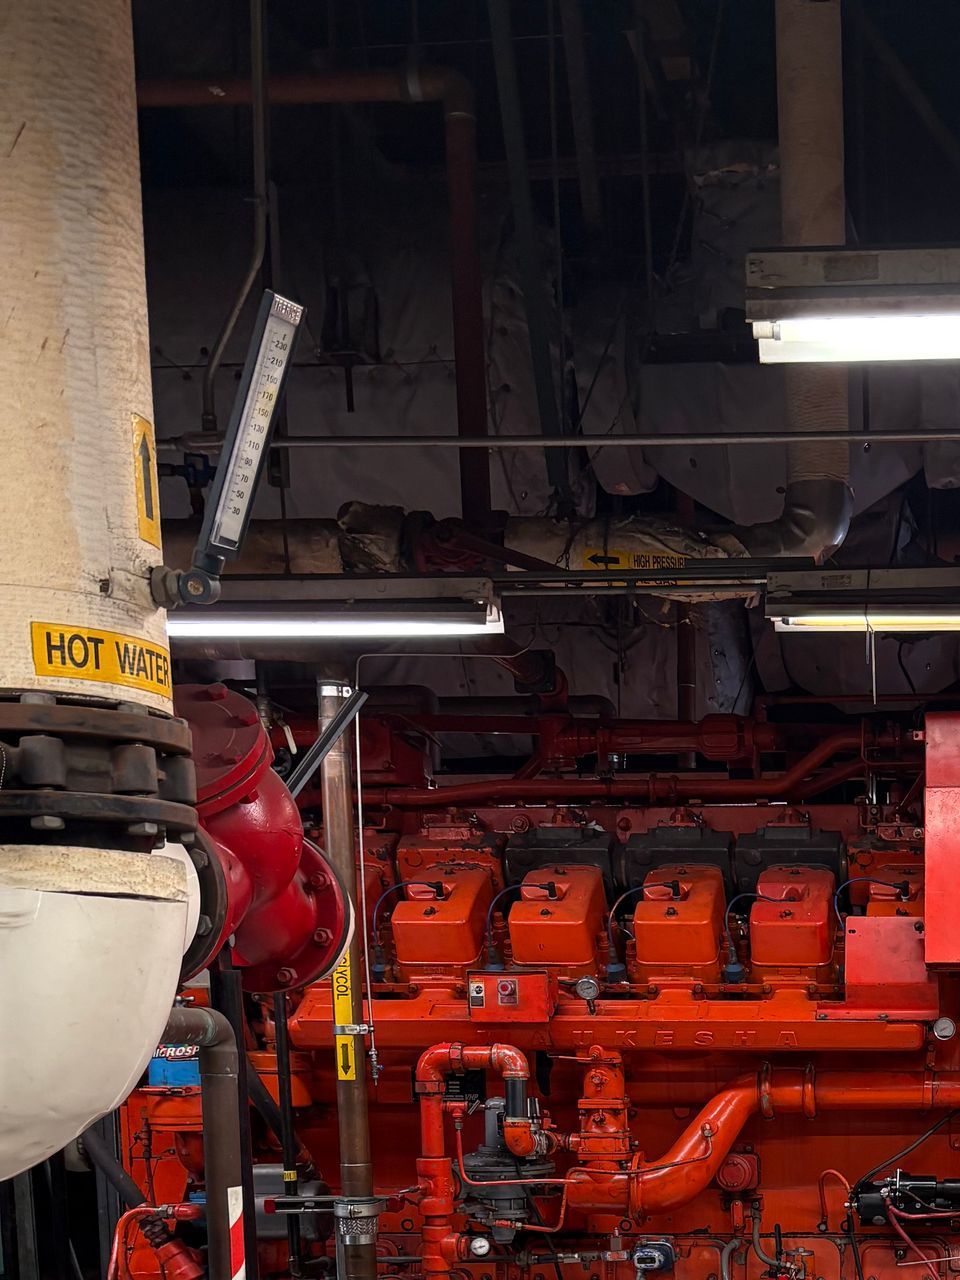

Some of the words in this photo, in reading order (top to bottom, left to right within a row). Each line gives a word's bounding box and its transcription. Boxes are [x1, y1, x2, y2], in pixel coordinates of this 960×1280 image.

[270, 356, 283, 367] 210
[262, 391, 274, 401] 170
[258, 408, 270, 418] 150
[253, 423, 265, 434] 130
[248, 440, 260, 450] 110
[240, 474, 249, 483] 70
[235, 490, 245, 499] 50
[232, 506, 241, 515] 30
[633, 555, 650, 568] HIGH
[46, 631, 105, 671] HOT
[115, 641, 170, 688] WATER
[476, 1028, 799, 1048] AUKESHA
